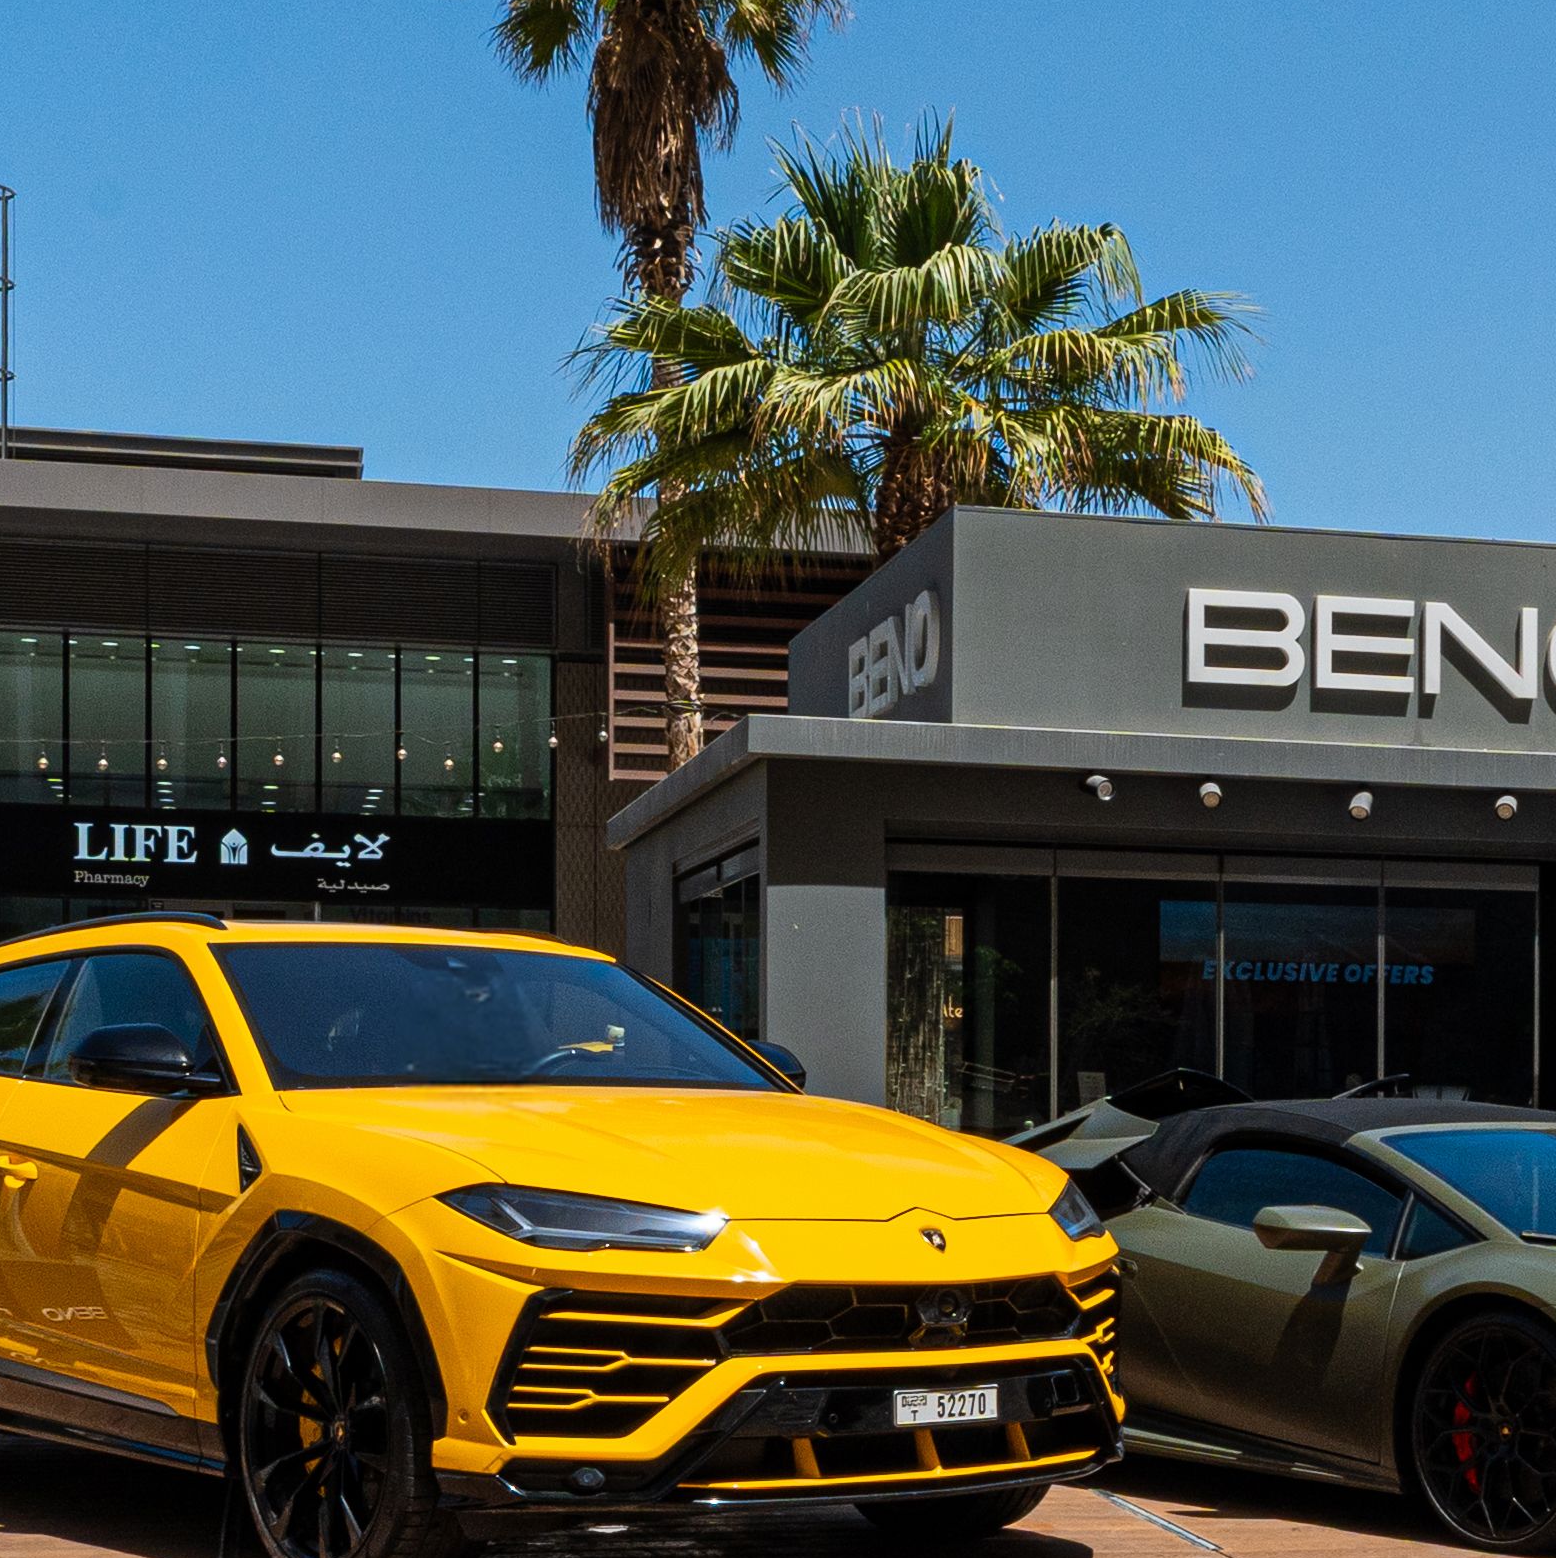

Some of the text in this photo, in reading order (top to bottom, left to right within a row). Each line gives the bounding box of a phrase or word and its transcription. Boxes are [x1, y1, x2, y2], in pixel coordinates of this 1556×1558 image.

[848, 590, 940, 719] BENO
[73, 823, 198, 863] LIFE
[270, 832, 391, 867] لايف
[73, 870, 150, 888] Pharmacy
[316, 876, 391, 893] صيدلية
[1201, 959, 1340, 983] EXCLUSIVE
[910, 1410, 919, 1421] T
[937, 1392, 986, 1418] 52270
